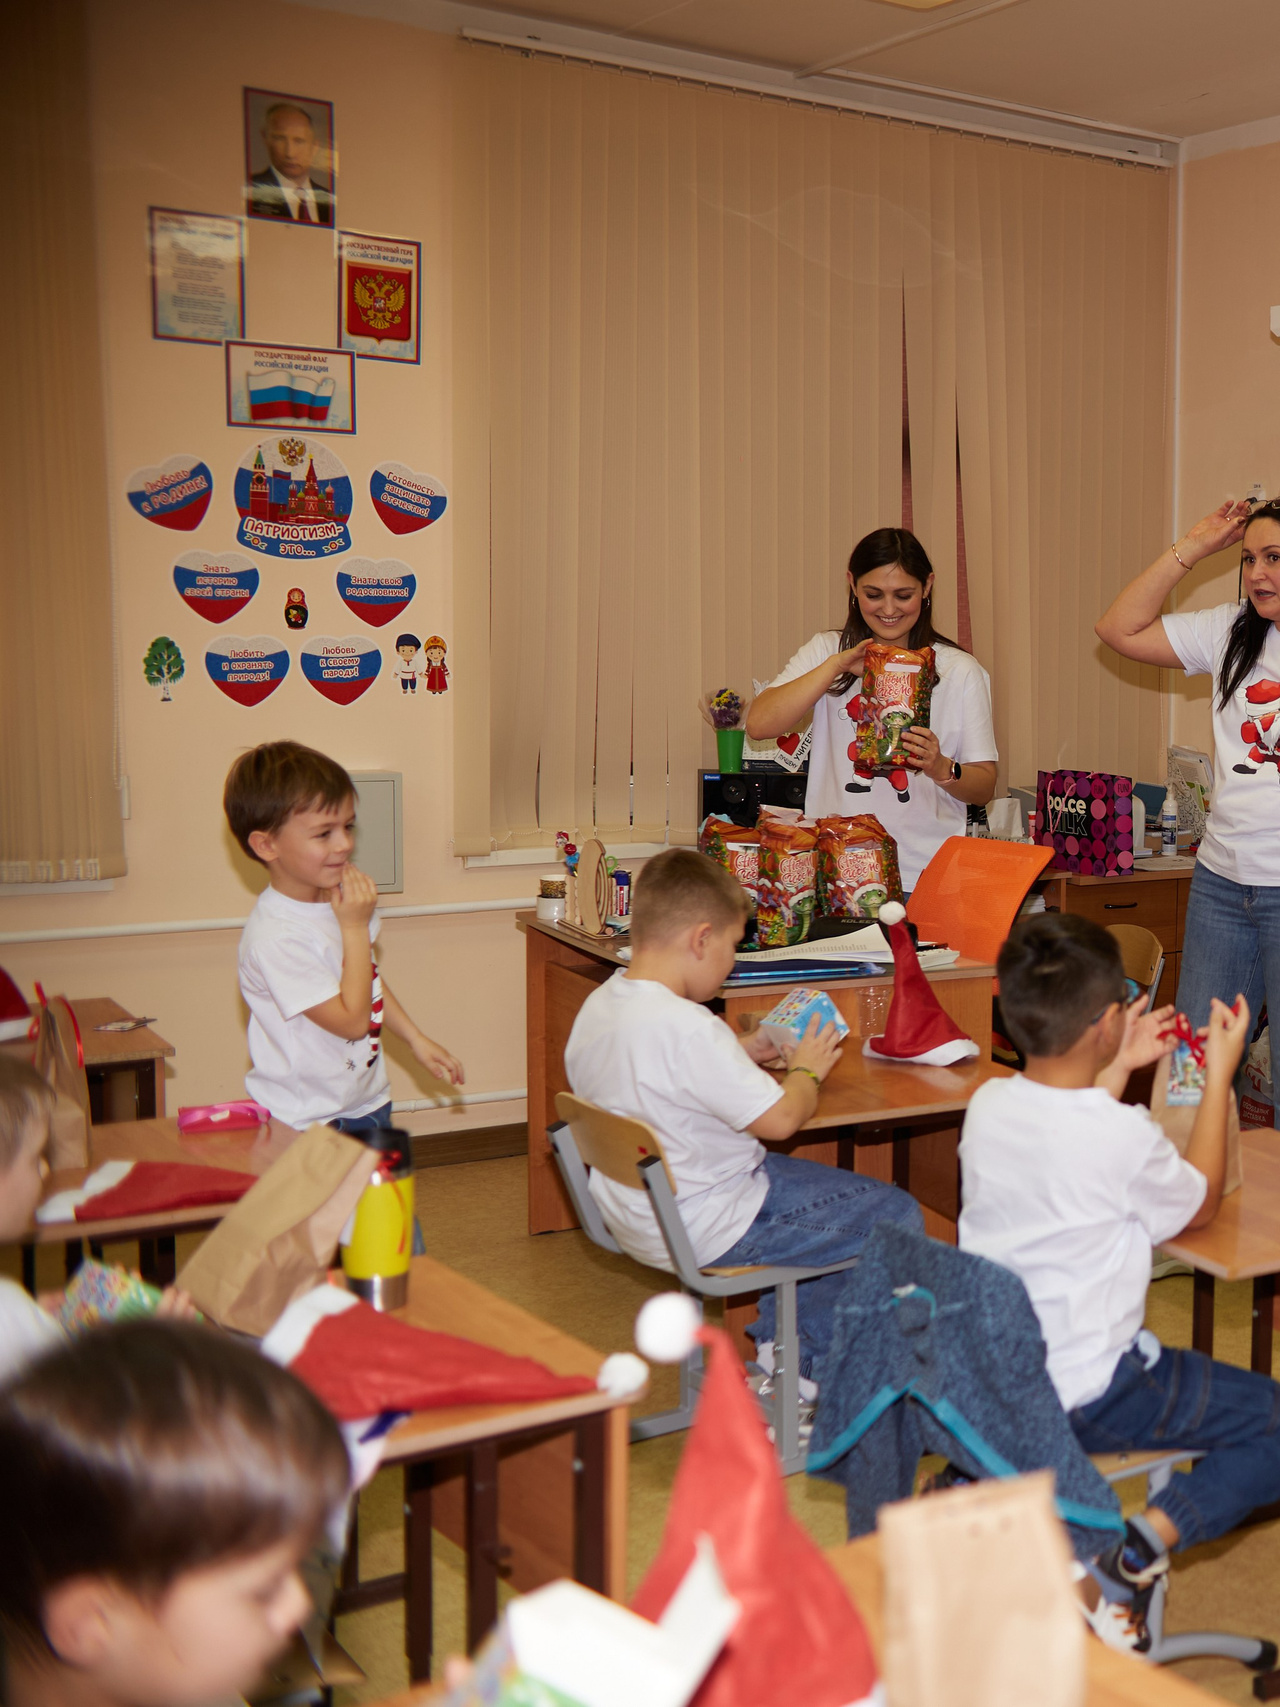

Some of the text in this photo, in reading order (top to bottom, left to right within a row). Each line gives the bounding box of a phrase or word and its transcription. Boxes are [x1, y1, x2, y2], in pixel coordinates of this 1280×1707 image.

[346, 241, 400, 254] ГОСУДАРСТВЕННЫЙ
[382, 255, 414, 265] ФЕДЕРАЦИИ
[254, 350, 312, 362] ГОСУДАРСТВЕННЫЙ
[254, 360, 329, 373] РОССИЙСКОЙ ФЕДЕРАЦИИ
[144, 470, 190, 495] Любовь
[387, 471, 435, 496] Готовность
[151, 475, 208, 509] РОДИНЕ!
[385, 484, 431, 506] защищать
[381, 493, 430, 517] Отечество!
[280, 544, 316, 555] ЭТО...
[203, 564, 230, 573] Знать
[196, 577, 238, 585] историю
[351, 576, 377, 584] Знать
[185, 587, 249, 597] своей страны
[346, 588, 409, 597] родословную!
[229, 650, 265, 658] Любить
[322, 646, 356, 655] Любовь
[328, 658, 360, 666] своему
[228, 671, 270, 681] природу!
[323, 667, 359, 677] народу!
[794, 728, 813, 760] УЧИТЕЛ
[778, 754, 798, 769] ЛУЧШЕМУ
[1118, 784, 1129, 793] FUN!
